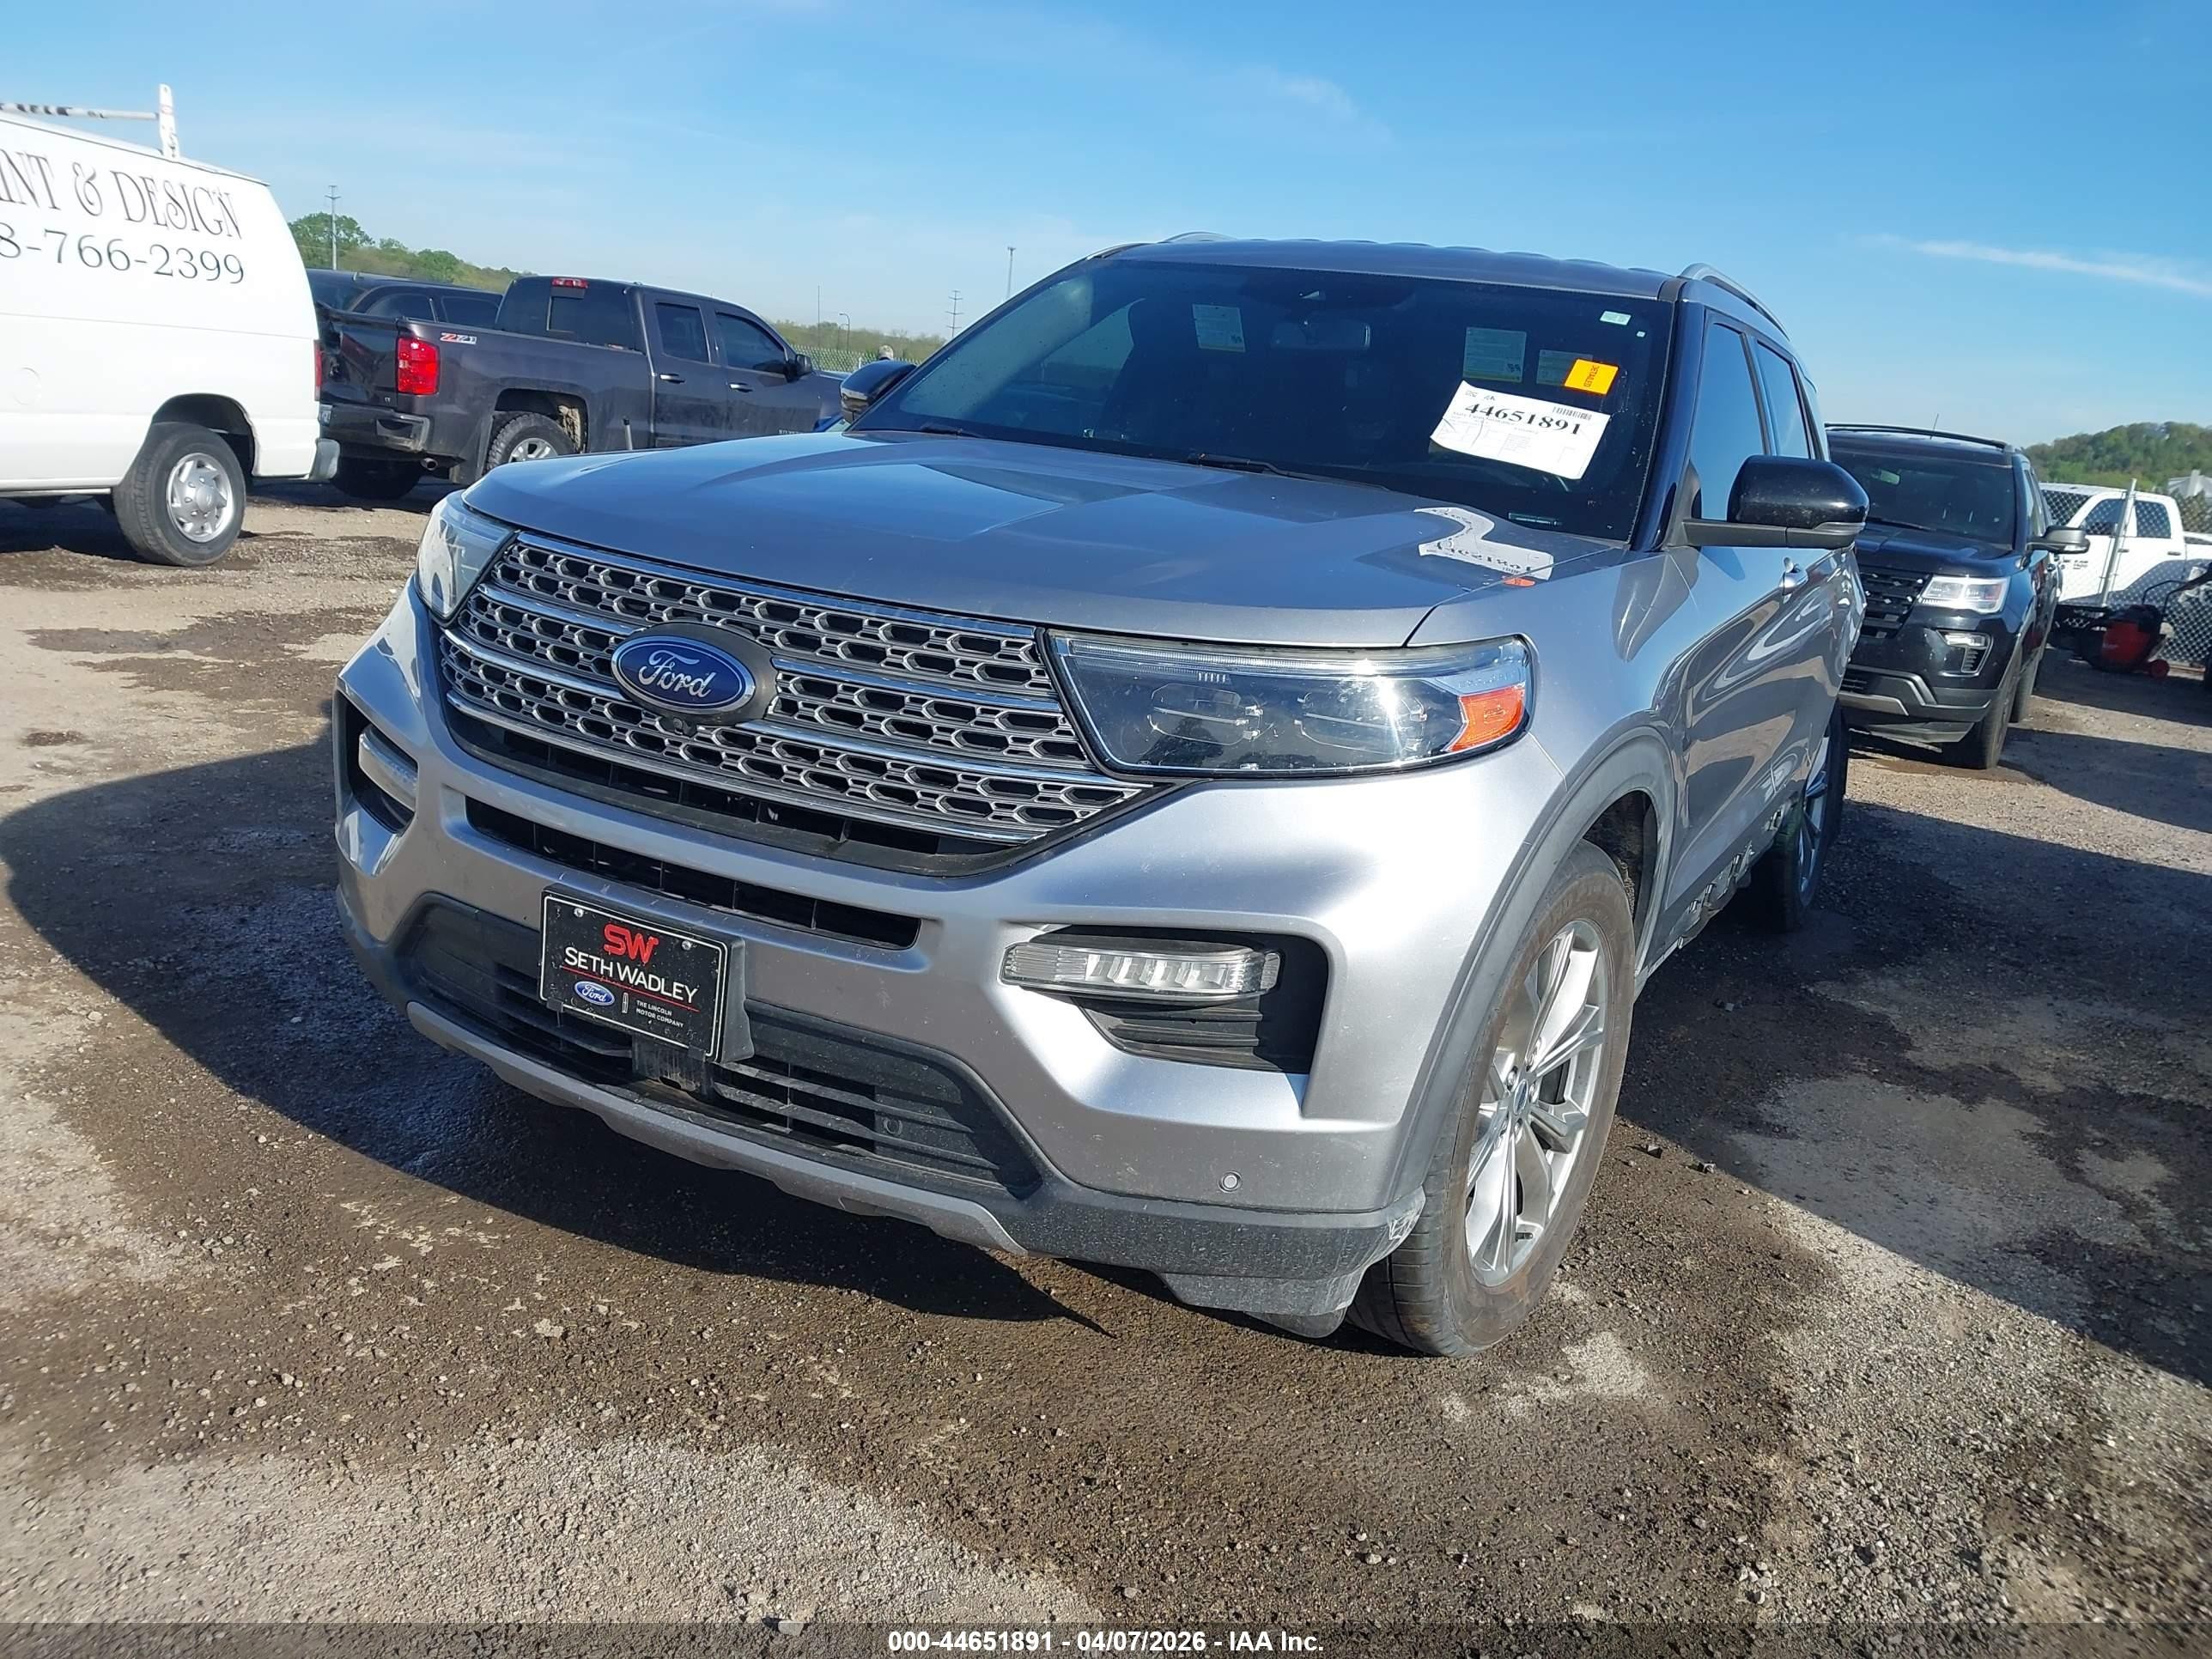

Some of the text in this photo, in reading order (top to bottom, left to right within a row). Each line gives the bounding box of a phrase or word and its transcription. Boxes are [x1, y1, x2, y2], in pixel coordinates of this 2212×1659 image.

[72, 161, 103, 216] &
[110, 170, 241, 240] DESIGN
[0, 222, 244, 284] 8-766-2399
[1465, 404, 1580, 435] 44651891
[638, 649, 716, 698] Ford
[604, 924, 659, 963] SW
[564, 946, 699, 1004] SETH WADLEY
[581, 984, 608, 1002] Ford
[636, 1000, 672, 1016] THE LINCOLN
[636, 1007, 684, 1028] MOTOR COMPANY
